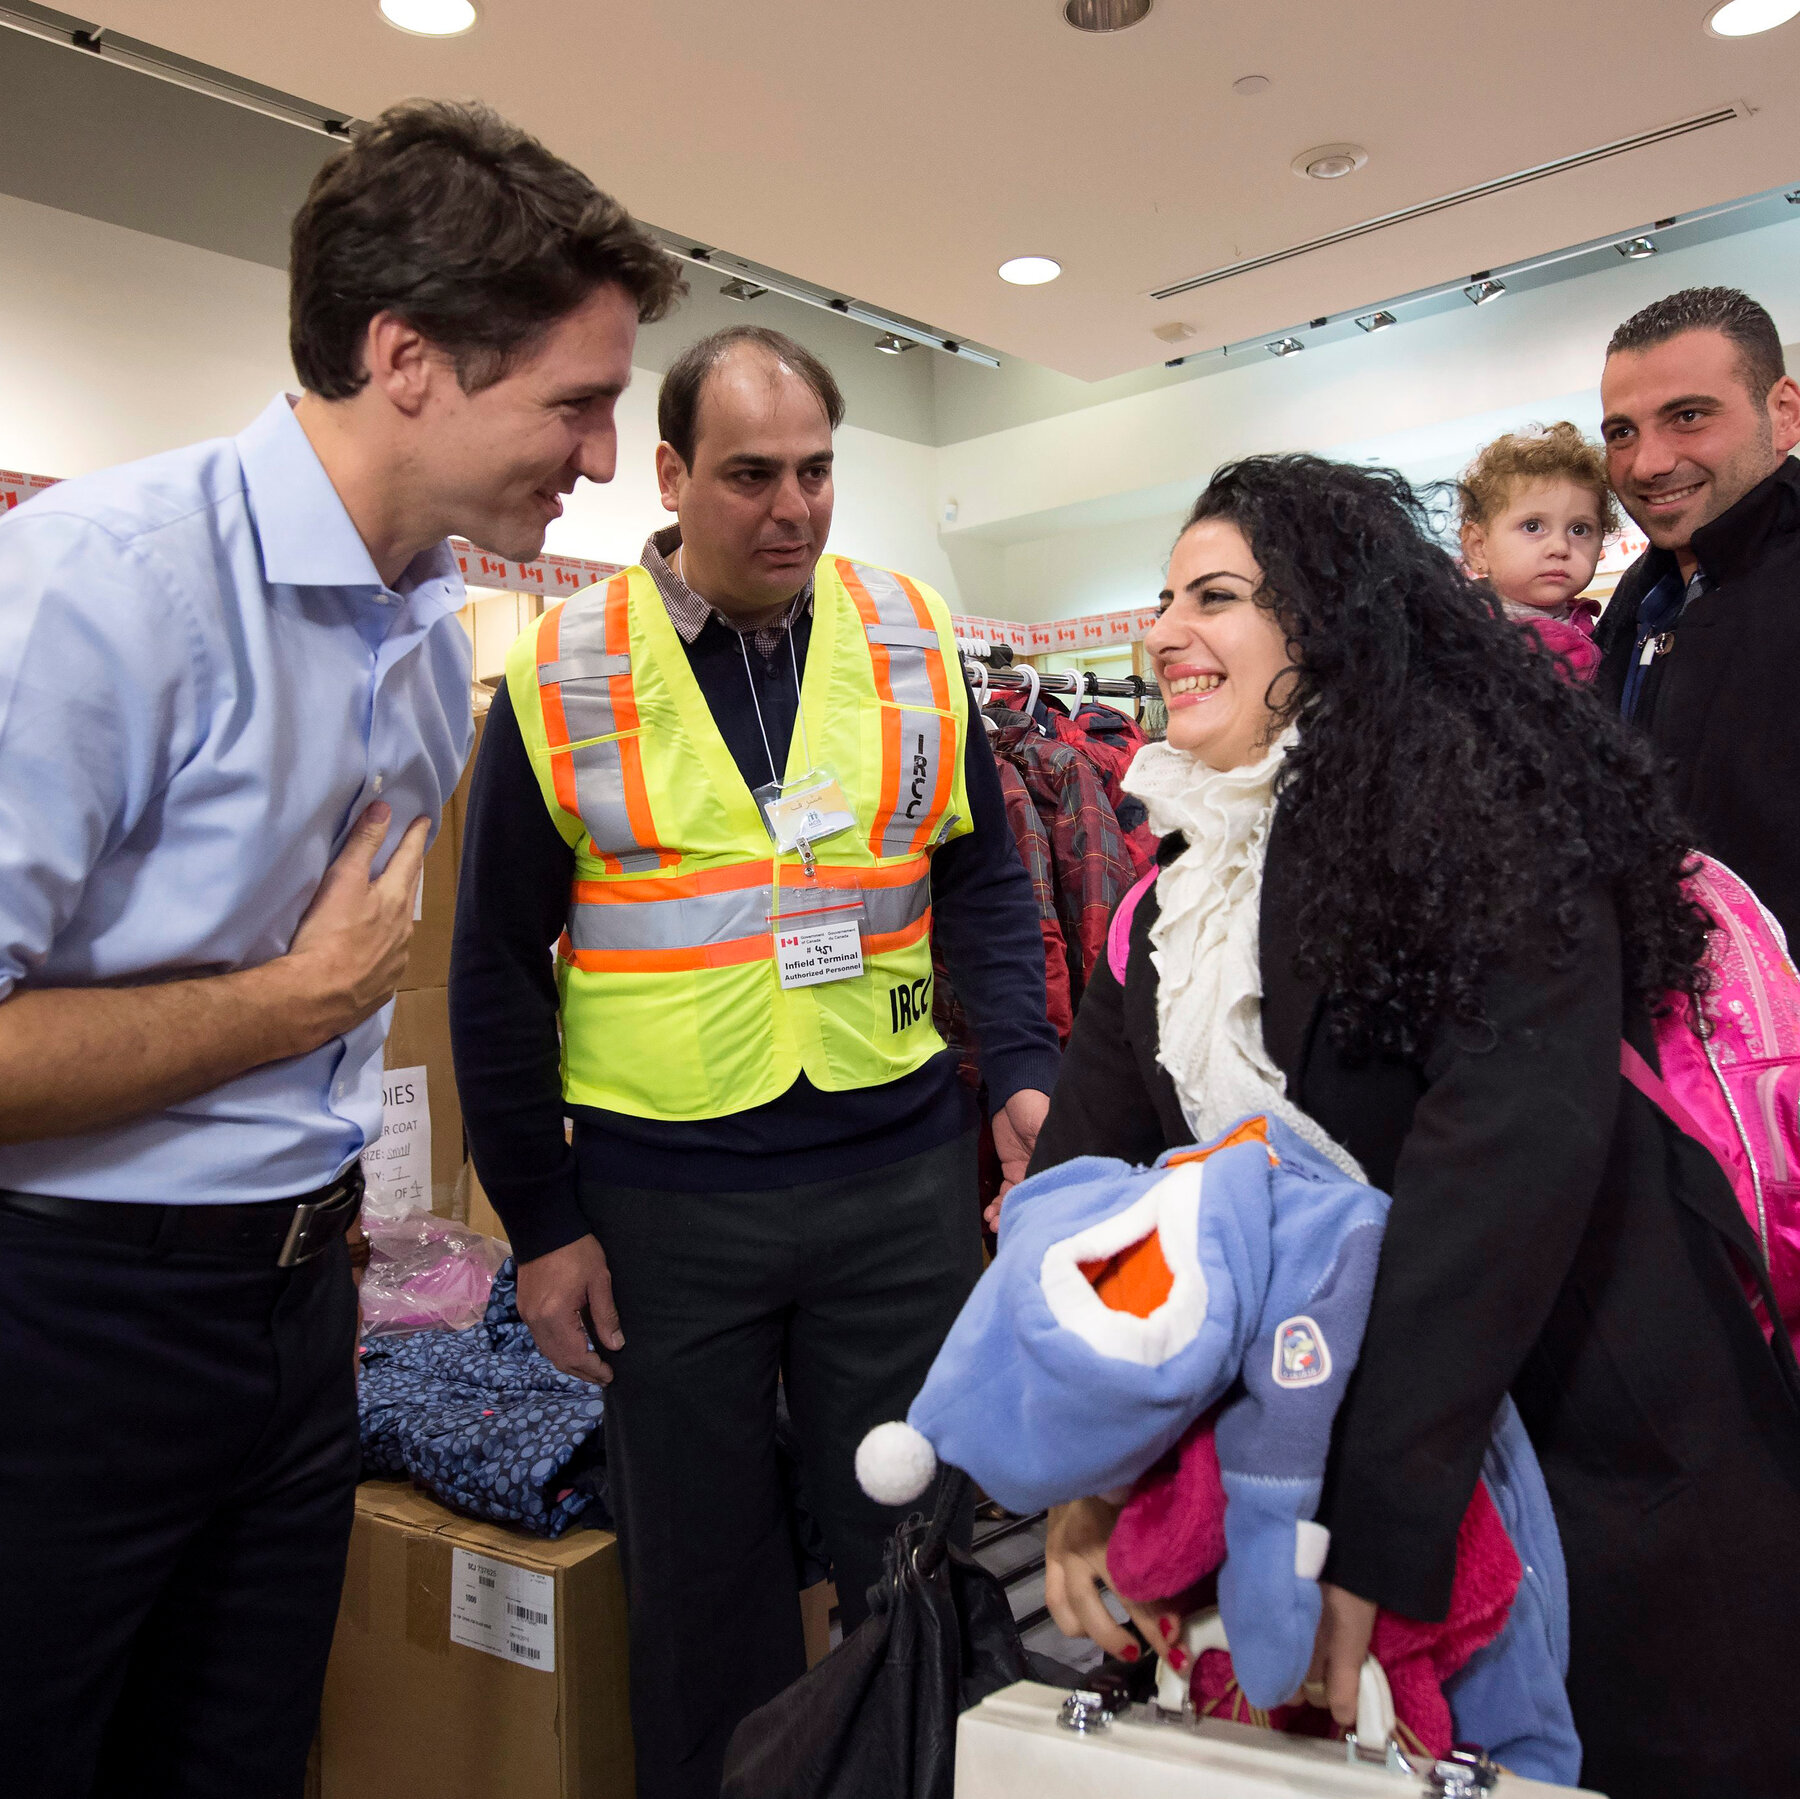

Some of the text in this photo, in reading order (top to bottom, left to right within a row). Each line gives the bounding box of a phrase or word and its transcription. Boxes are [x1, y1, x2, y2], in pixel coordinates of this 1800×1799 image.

[903, 733, 928, 819] IRCC
[800, 932, 825, 940] Government
[785, 952, 858, 970] Infield Terminal
[785, 963, 861, 981] Authorized Personnel
[392, 1120, 418, 1134] COAT
[361, 1150, 385, 1162] SIZE:
[394, 1188, 408, 1200] OF
